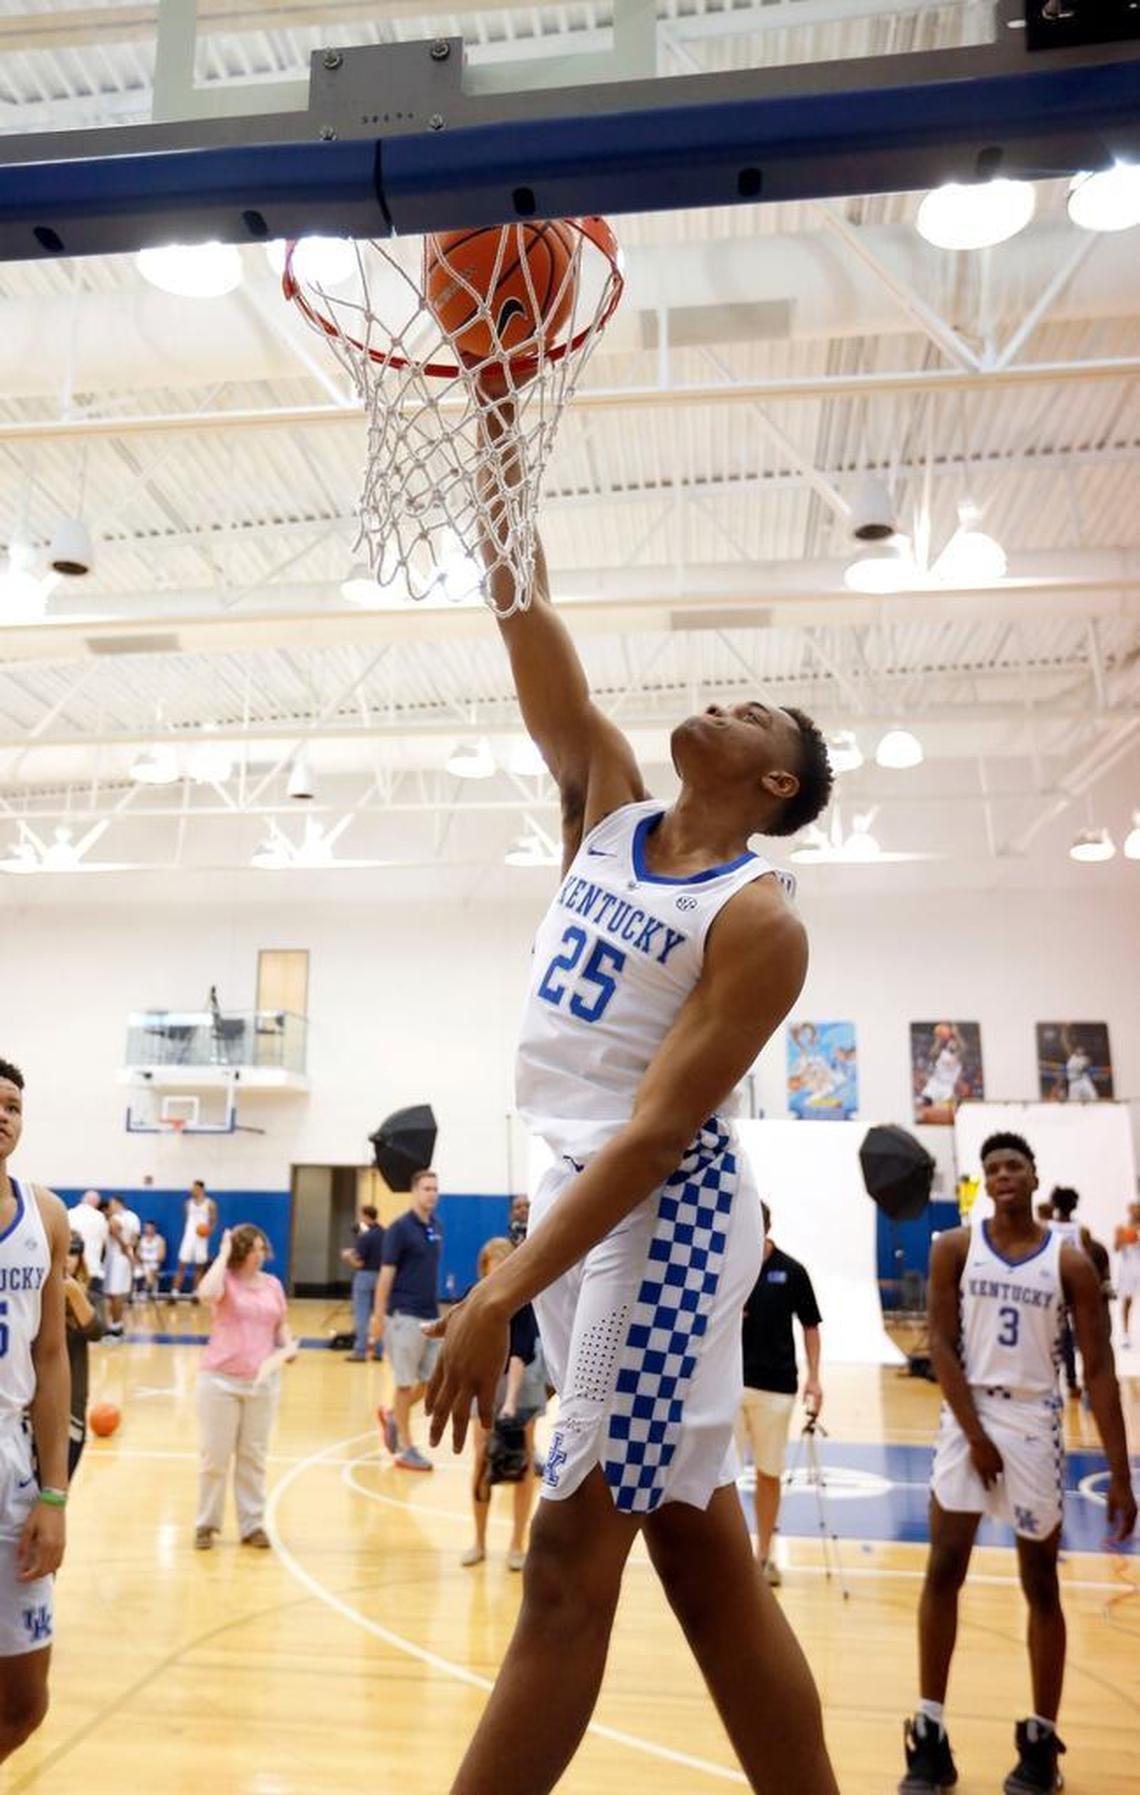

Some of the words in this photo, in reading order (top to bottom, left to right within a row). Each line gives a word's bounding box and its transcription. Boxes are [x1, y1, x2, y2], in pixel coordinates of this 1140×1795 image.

[560, 875, 685, 964] KENTUCKY
[538, 925, 627, 1024] 25
[969, 1280, 1053, 1309] KENTUCKY
[997, 1306, 1020, 1348] 3
